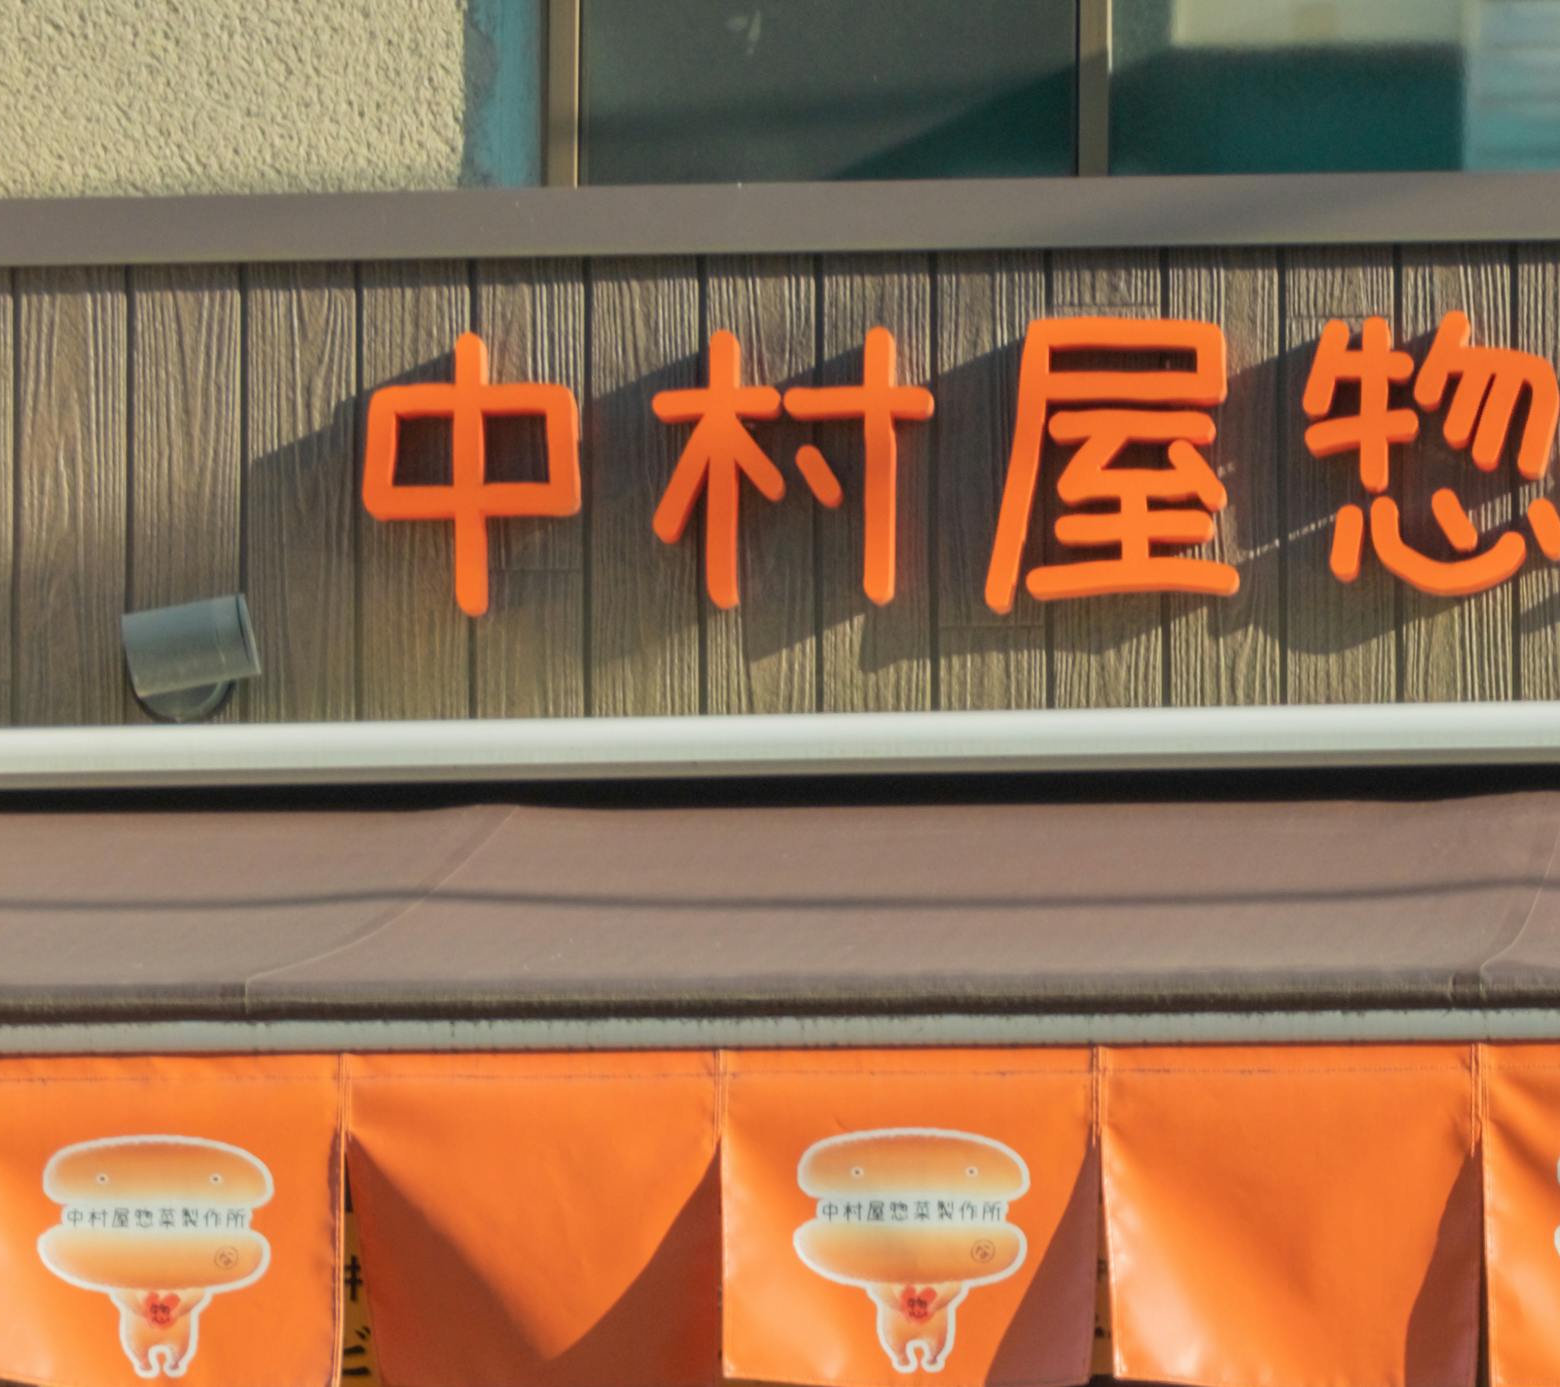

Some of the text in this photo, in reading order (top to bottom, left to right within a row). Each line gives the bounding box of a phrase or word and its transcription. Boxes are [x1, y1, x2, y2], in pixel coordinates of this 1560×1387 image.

[63, 1203, 248, 1231] 中村屋惣菜製作所
[820, 1198, 1005, 1224] 中村屋惣菜製作所
